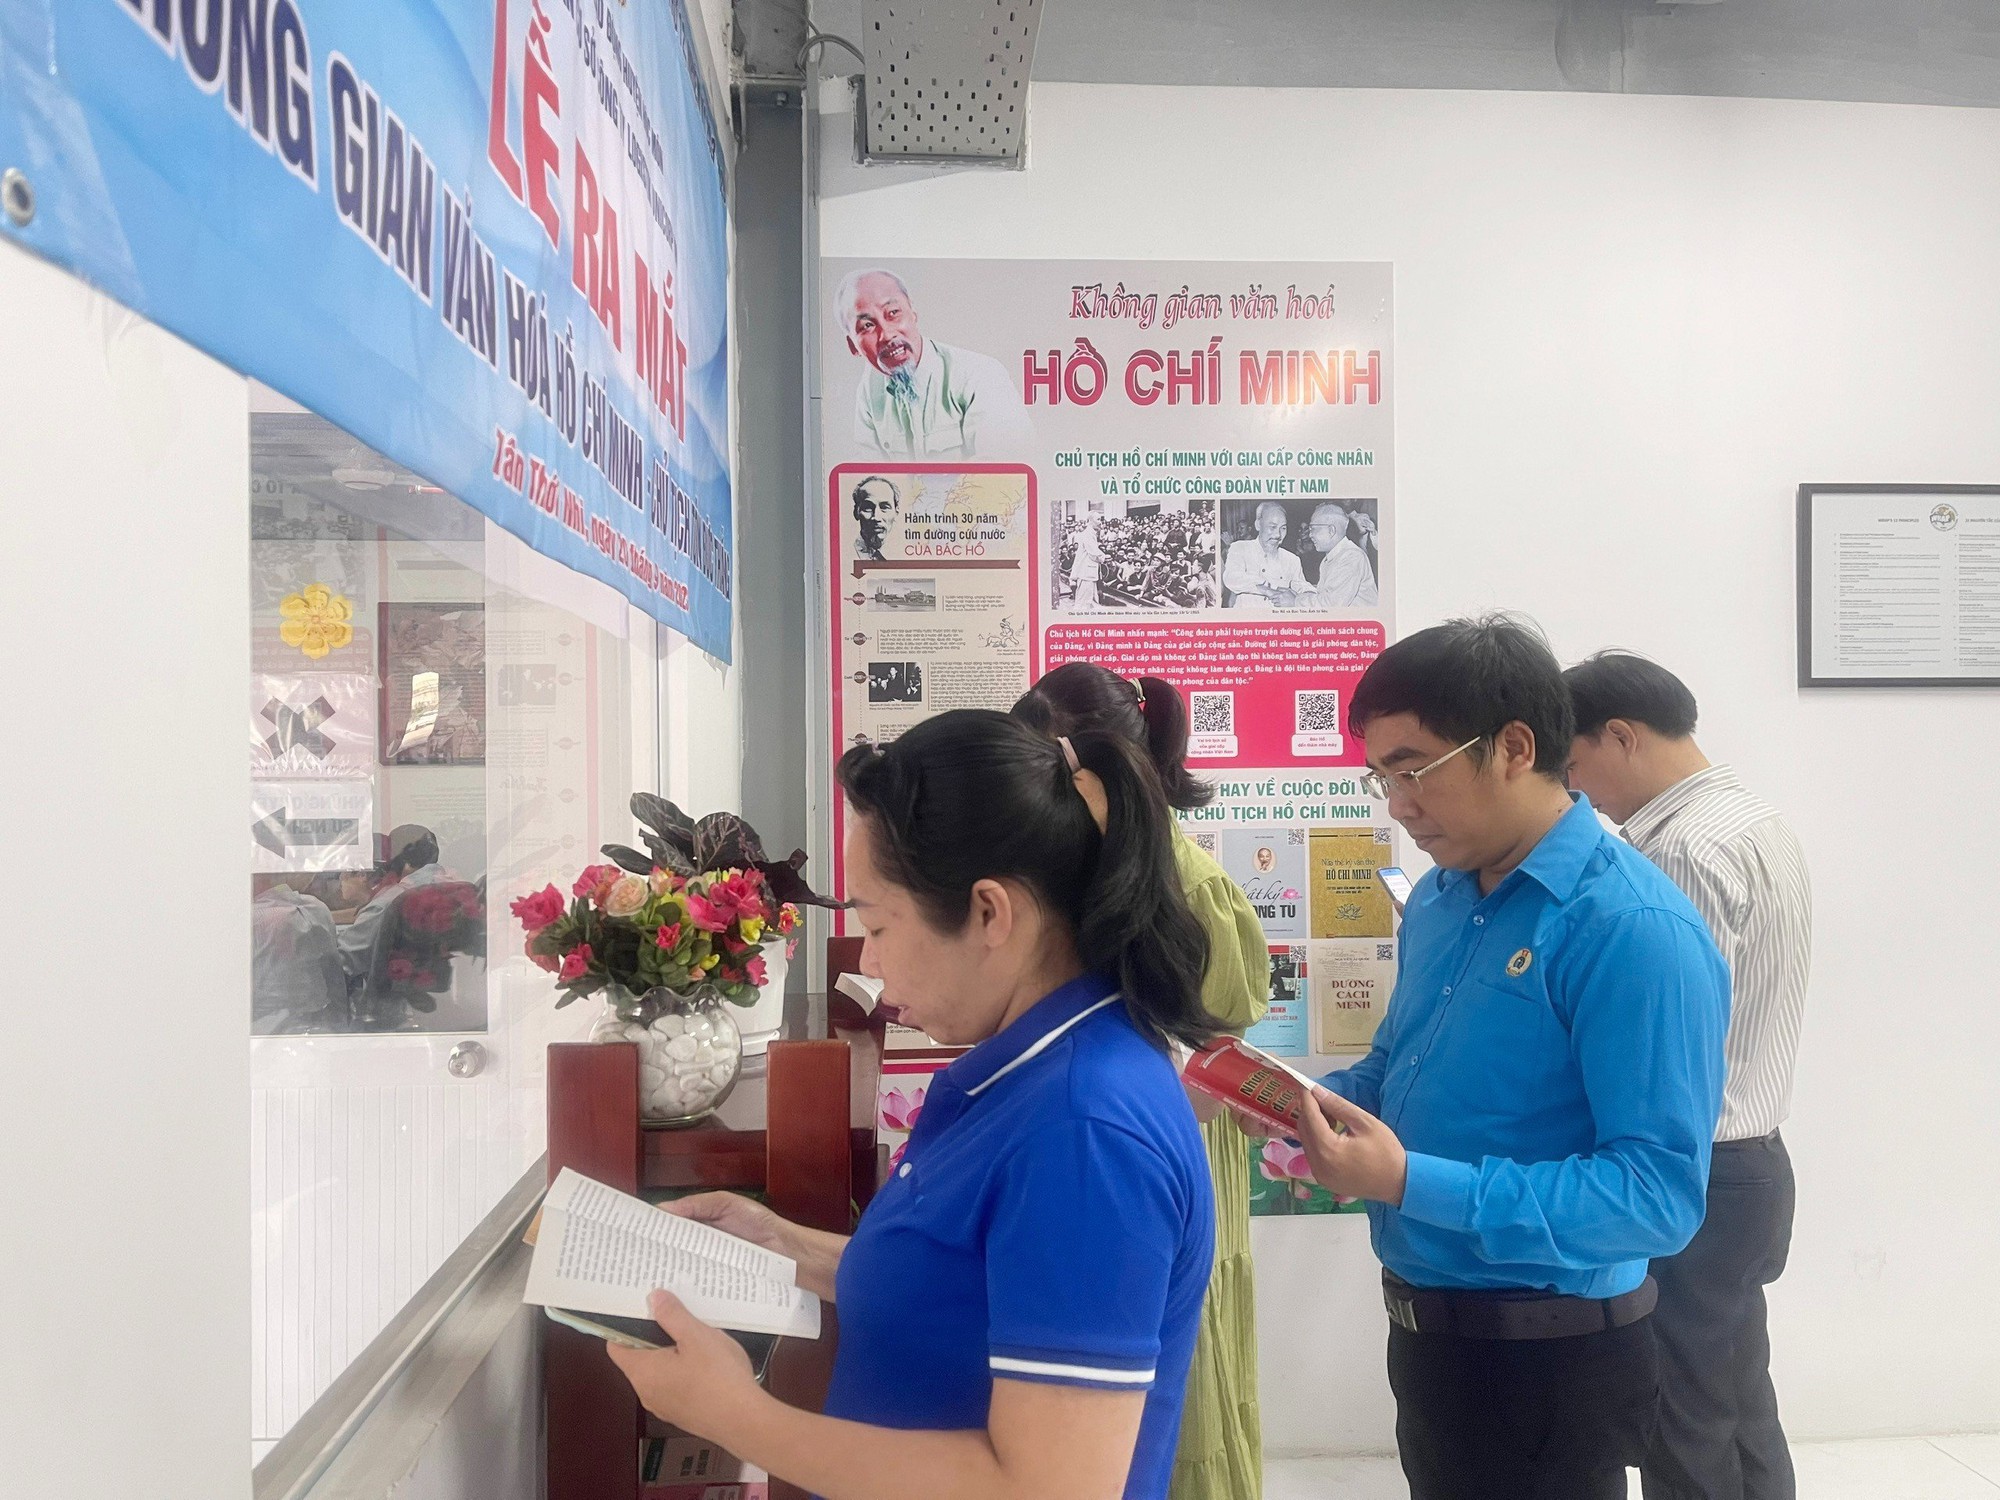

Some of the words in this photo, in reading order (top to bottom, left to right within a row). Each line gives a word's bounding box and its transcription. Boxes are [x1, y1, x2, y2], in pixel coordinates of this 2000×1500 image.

[329, 59, 434, 299] GIAN
[443, 182, 497, 369] VĂN
[554, 320, 577, 444] HỒ
[582, 370, 607, 476] CHÍ
[608, 401, 644, 512] MINH
[572, 136, 622, 354] RA
[635, 250, 687, 444] MẮT
[1069, 282, 1157, 329] Không
[1162, 284, 1222, 330] gian
[1229, 283, 1278, 320] văn
[1285, 283, 1336, 320] hoá
[1023, 336, 1108, 406] HỒ
[1124, 336, 1223, 406] CHÍ
[1239, 349, 1382, 406] MINH
[493, 427, 524, 492] Tân
[1055, 447, 1082, 467] CHỦ
[1087, 452, 1118, 470] TỊCH
[1122, 446, 1141, 467] HỒ
[1145, 448, 1168, 467] CHÍ
[1172, 452, 1206, 467] MINH
[1211, 447, 1233, 466] VỚI
[1237, 452, 1263, 466] GIAI
[1267, 446, 1293, 466] CẤP
[1297, 448, 1333, 466] CÔNG
[1337, 448, 1374, 466] NHÂN
[1101, 475, 1118, 495] VÀ
[1122, 472, 1142, 494] TỔ
[1145, 475, 1182, 495] CHỨC
[1185, 474, 1222, 494] CÔNG
[1225, 474, 1262, 494] ĐOÀN
[1266, 475, 1296, 496] VIỆT
[1300, 478, 1329, 493] NAM
[904, 512, 931, 524] Hành
[934, 512, 958, 524] trình
[961, 513, 974, 524] 30
[976, 514, 998, 524] năm
[904, 529, 921, 540] tìm
[923, 529, 956, 542] đường
[959, 529, 978, 540] cứu
[980, 529, 1006, 540] nước
[904, 541, 932, 556] CỦA
[936, 542, 962, 556] BÁC
[965, 541, 985, 556] HỒ
[1049, 629, 1063, 638] Chủ
[1065, 629, 1079, 638] tịch
[1107, 628, 1125, 637] Minh
[1126, 629, 1144, 637] nhấn
[1146, 628, 1168, 637] mạnh:
[1195, 628, 1213, 636] đoàn
[1215, 627, 1230, 637] phải
[1232, 628, 1252, 636] tuyên
[1337, 626, 1354, 635] sách
[1356, 626, 1378, 636] chung
[1049, 641, 1062, 650] của
[1064, 641, 1085, 651] Đảng,
[1095, 641, 1113, 650] Đảng
[1143, 640, 1162, 650] Đảng
[1163, 640, 1177, 649] của
[1178, 641, 1192, 650] giai
[1193, 641, 1206, 649] cấp
[1208, 640, 1226, 649] cộng
[1279, 640, 1300, 649] chung
[1302, 639, 1309, 647] là
[1311, 639, 1324, 648] giải
[1326, 639, 1348, 648] phóng
[1350, 639, 1363, 647] dân
[1364, 639, 1378, 647] tộc,
[1049, 653, 1063, 663] giải
[1064, 654, 1087, 663] phóng
[1103, 653, 1118, 663] cấp.
[1120, 653, 1134, 662] Giai
[1136, 653, 1149, 662] cấp
[1151, 653, 1162, 661] mà
[1163, 653, 1186, 662] không
[1187, 653, 1196, 661] có
[1198, 652, 1217, 662] Đảng
[1218, 652, 1234, 660] lãnh
[1235, 652, 1248, 661] đạo
[1261, 652, 1283, 661] không
[1300, 651, 1317, 660] cách
[1318, 652, 1338, 660] mạng
[1112, 666, 1126, 675] cấp
[1127, 666, 1145, 675] công
[1147, 666, 1165, 674] nhân
[1186, 665, 1208, 674] không
[1209, 664, 1223, 673] làm
[1225, 664, 1242, 674] được
[1254, 664, 1273, 674] Đảng
[1274, 664, 1282, 672] là
[1283, 664, 1295, 672] đội
[1312, 664, 1334, 673] phong
[1335, 663, 1349, 671] của
[1350, 663, 1364, 672] giai
[1181, 677, 1204, 686] phong
[1205, 676, 1219, 685] của
[1220, 676, 1234, 685] dân
[1219, 783, 1250, 797] HAY
[1255, 777, 1276, 797] VỀ
[1281, 782, 1323, 799] CUỘC
[1328, 778, 1356, 796] ĐỜI
[1194, 802, 1226, 820] CHỦ
[1231, 806, 1267, 823] TỊCH
[1272, 800, 1295, 820] HỒ
[1299, 803, 1326, 819] CHÍ
[1331, 805, 1371, 819] MINH
[1352, 868, 1372, 880] MINH
